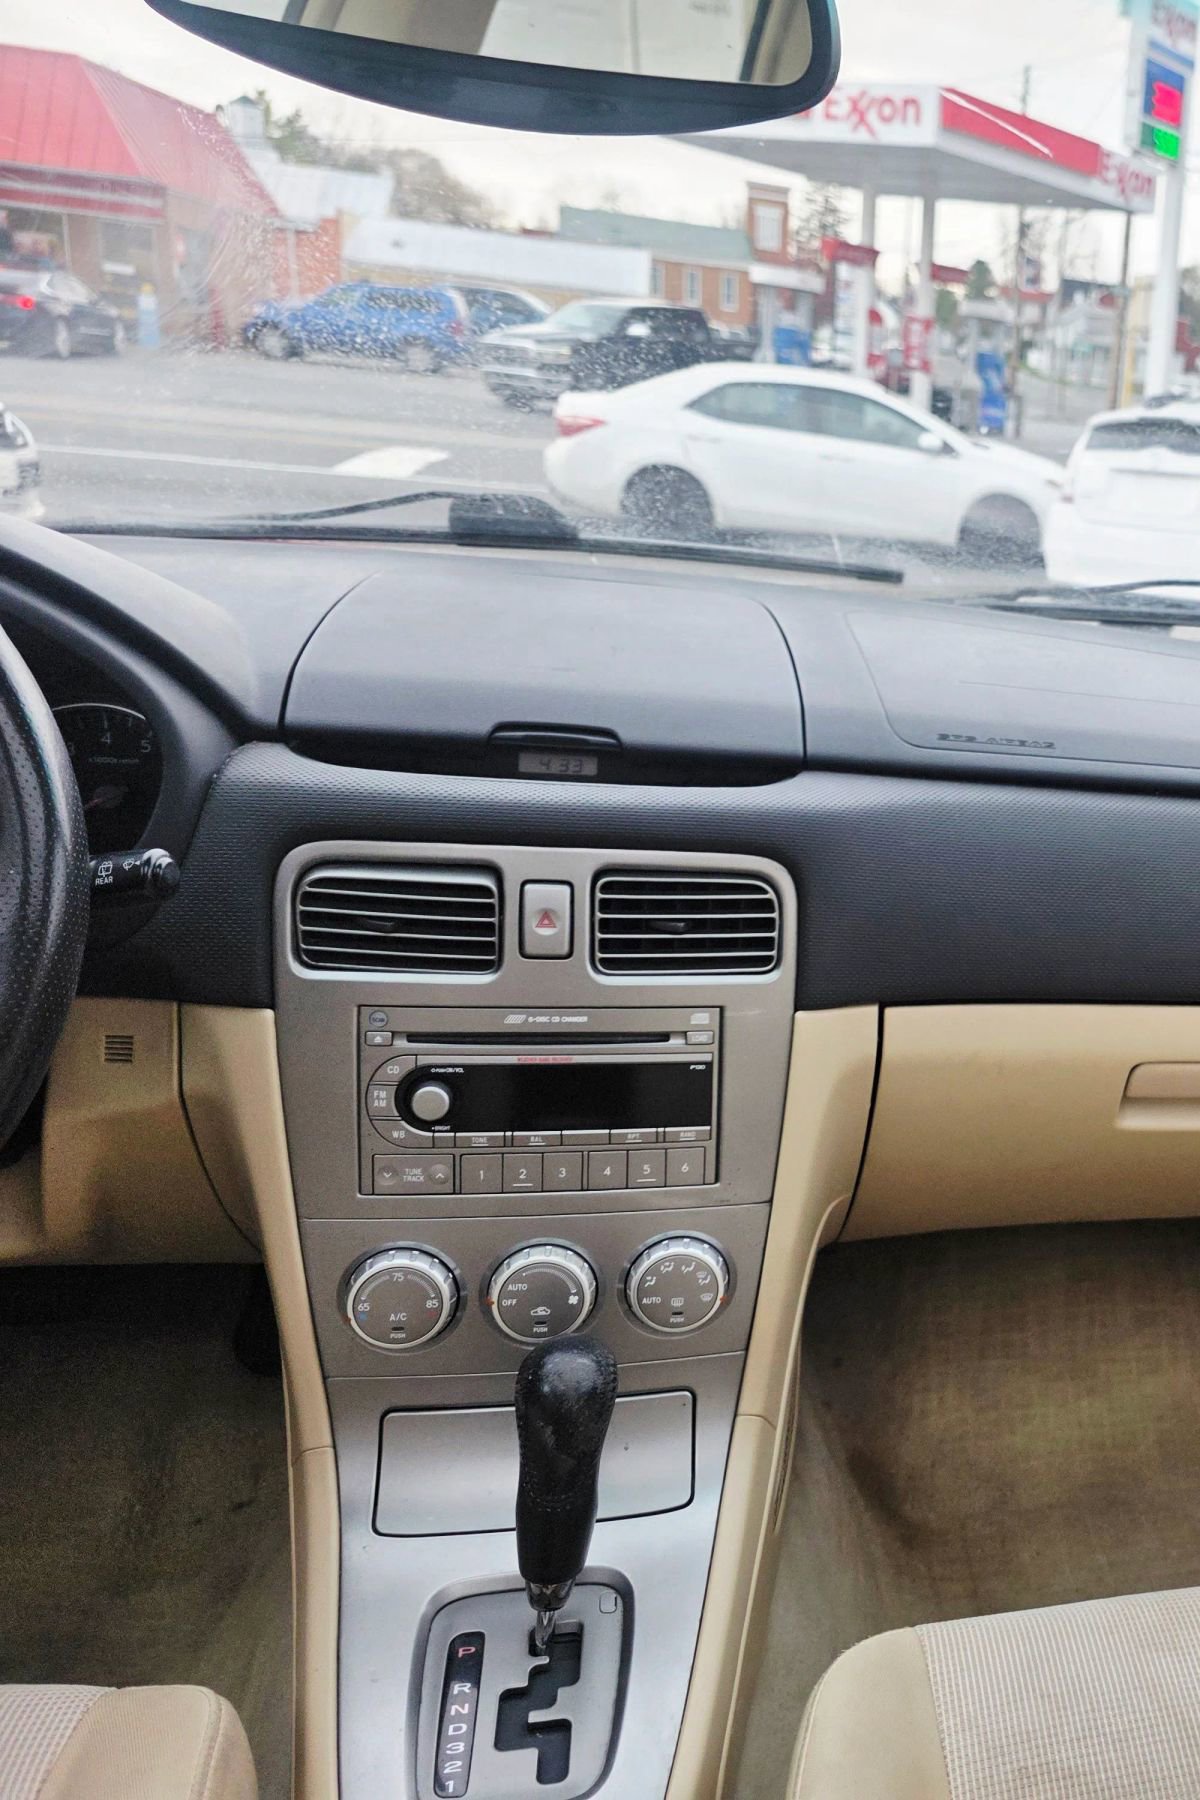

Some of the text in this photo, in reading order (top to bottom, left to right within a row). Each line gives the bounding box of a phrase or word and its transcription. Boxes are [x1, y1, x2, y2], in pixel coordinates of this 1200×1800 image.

[823, 88, 921, 142] Exxon
[1101, 148, 1154, 199] Exxon
[95, 876, 113, 886] REAR
[387, 1065, 400, 1074] CD
[373, 1090, 387, 1099] FM
[373, 1099, 387, 1107] AM
[392, 1130, 406, 1139] WB
[472, 1136, 488, 1144] TONE
[405, 1168, 423, 1176] TUNE
[559, 1168, 566, 1177] 3
[604, 1166, 611, 1176] 4
[643, 1165, 651, 1174] 5
[681, 1163, 689, 1173] 6
[519, 1169, 528, 1179] 2
[403, 1175, 425, 1183] TRACK
[391, 1272, 405, 1281] 75
[507, 1283, 528, 1291] AUTO
[425, 1300, 439, 1309] 85
[642, 1296, 661, 1304] AUTO
[357, 1303, 370, 1312] 65
[389, 1312, 408, 1322] A/C
[458, 1646, 476, 1658] P
[453, 1682, 472, 1695] R
[450, 1703, 469, 1716] N
[447, 1723, 468, 1736] D
[446, 1742, 465, 1755] 3
[443, 1760, 463, 1774] 2
[444, 1779, 454, 1793] 1
